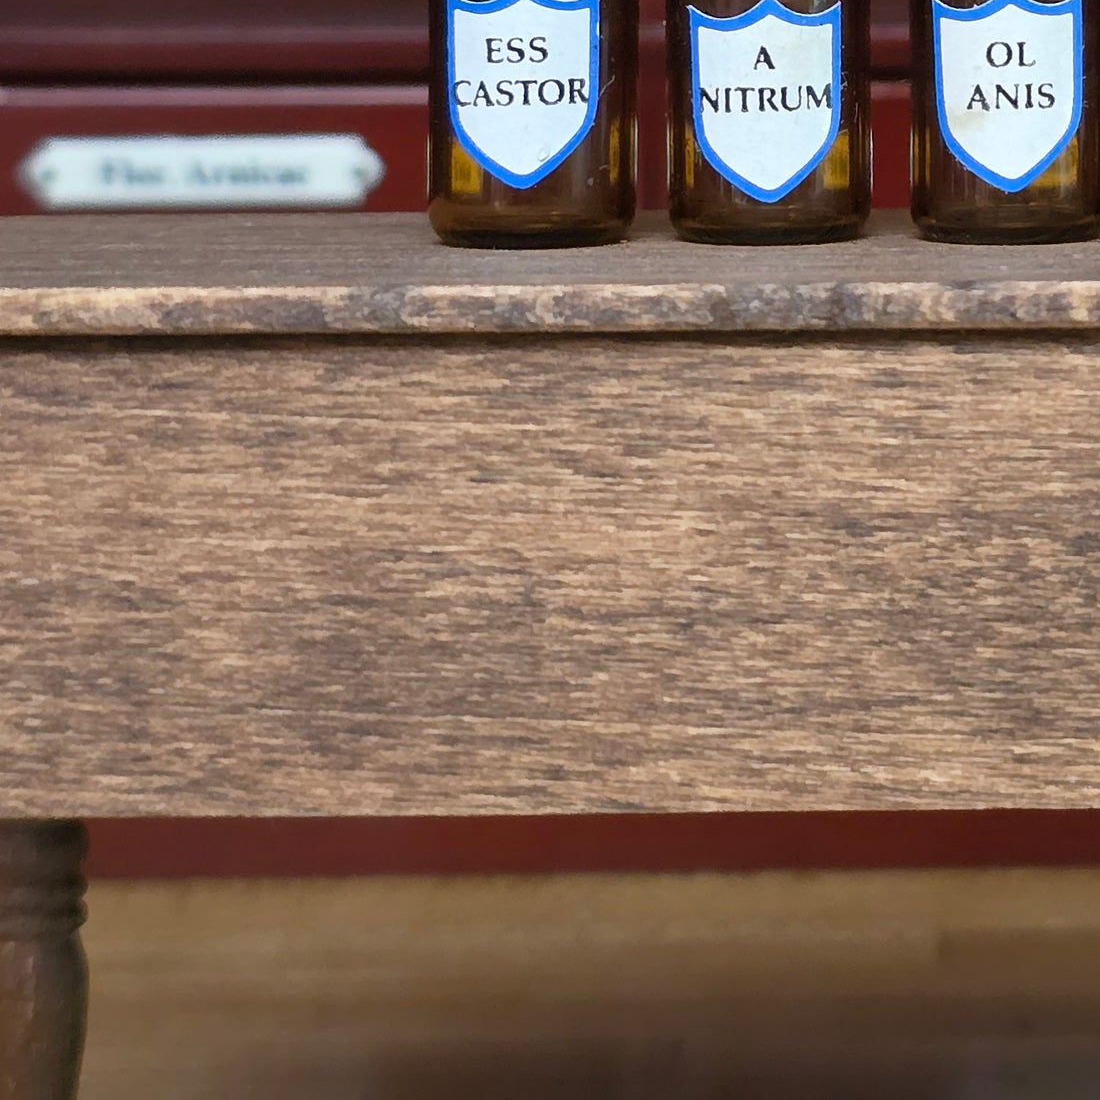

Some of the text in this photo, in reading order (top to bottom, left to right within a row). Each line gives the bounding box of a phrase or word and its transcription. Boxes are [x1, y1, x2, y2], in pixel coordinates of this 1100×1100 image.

[485, 36, 550, 64] ESS
[752, 45, 777, 71] A
[985, 40, 1036, 68] OL
[453, 77, 590, 108] CASTOR
[698, 82, 833, 114] NITRUM
[966, 82, 1057, 112] ANIS
